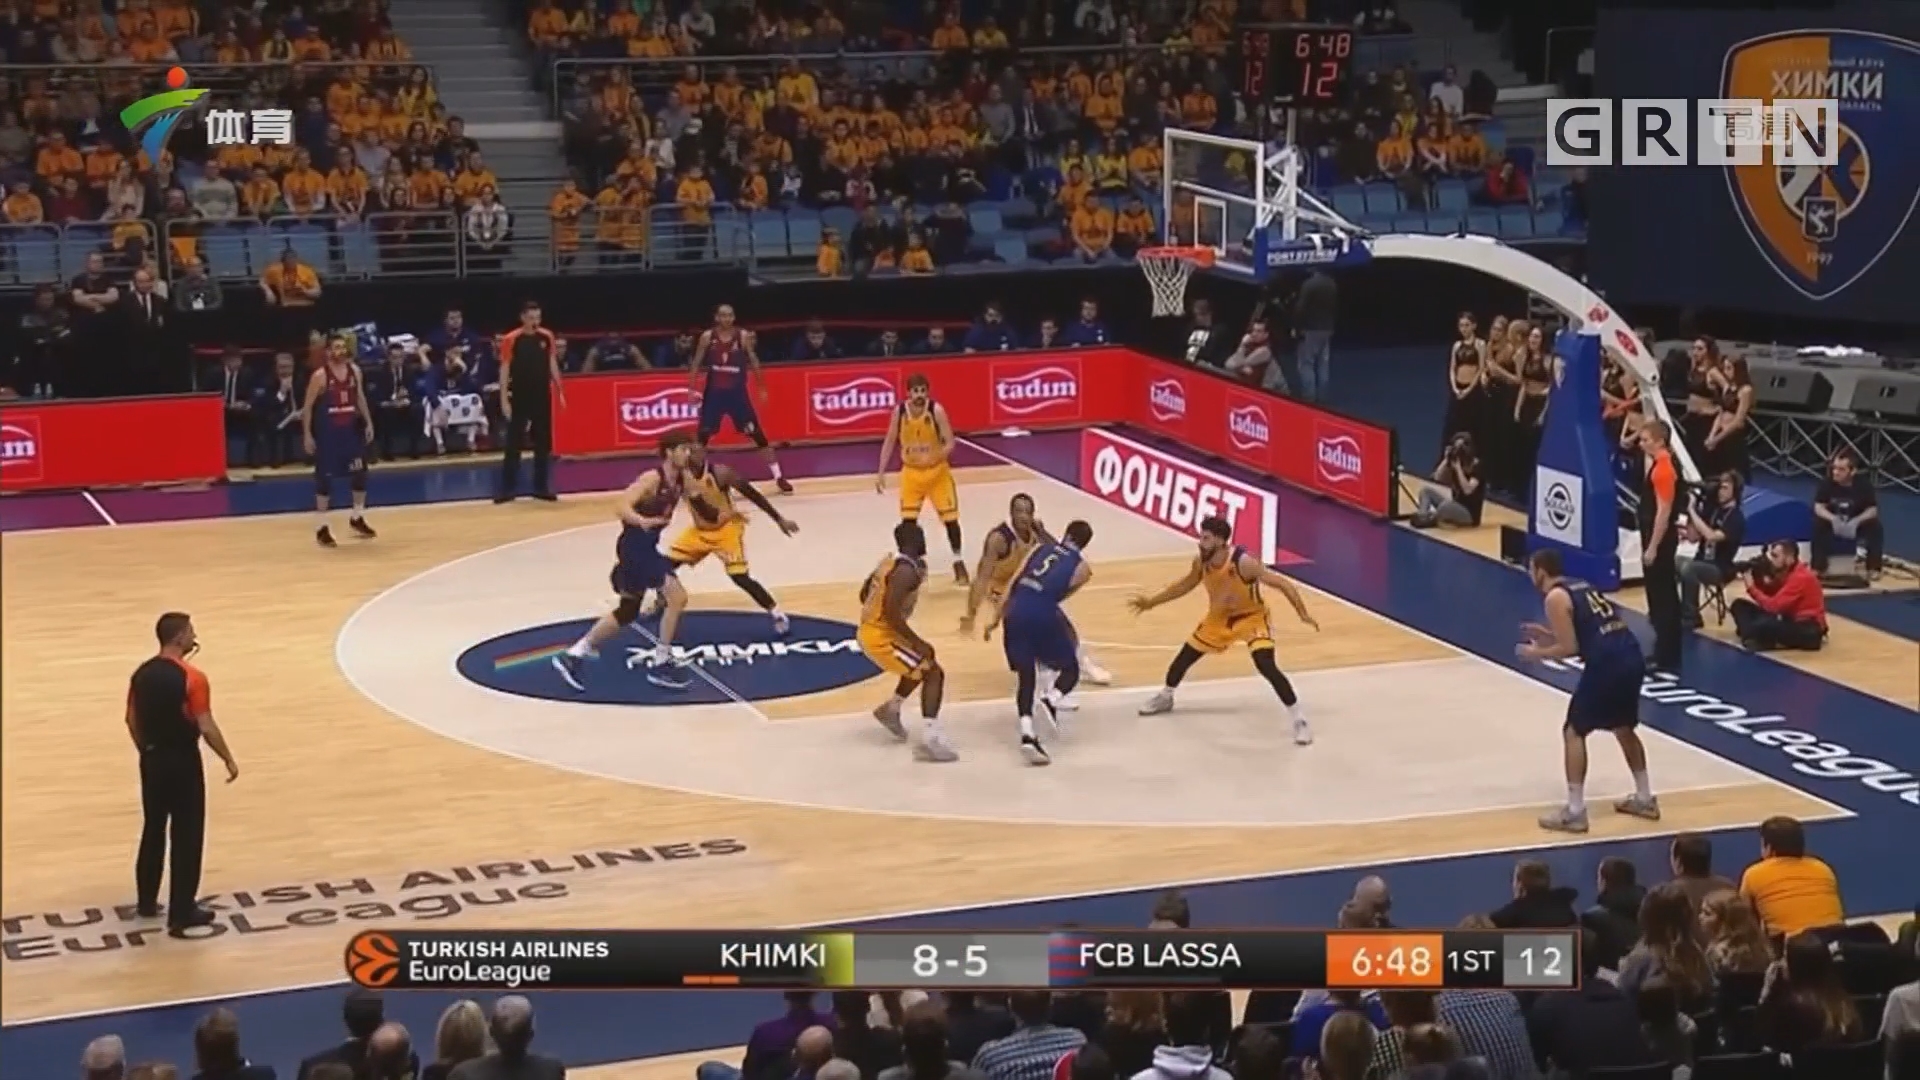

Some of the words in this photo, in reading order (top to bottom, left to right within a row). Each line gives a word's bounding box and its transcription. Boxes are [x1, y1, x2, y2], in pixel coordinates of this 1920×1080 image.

[1302, 62, 1338, 97] 12
[1770, 70, 1884, 100] ХИМКИ
[1094, 446, 1247, 546] ФОНБЕТ
[1032, 553, 1059, 577] 5
[1638, 670, 1920, 806] uroLeagu
[400, 838, 747, 890] AIRLINES
[1, 881, 570, 961] EuroLeague
